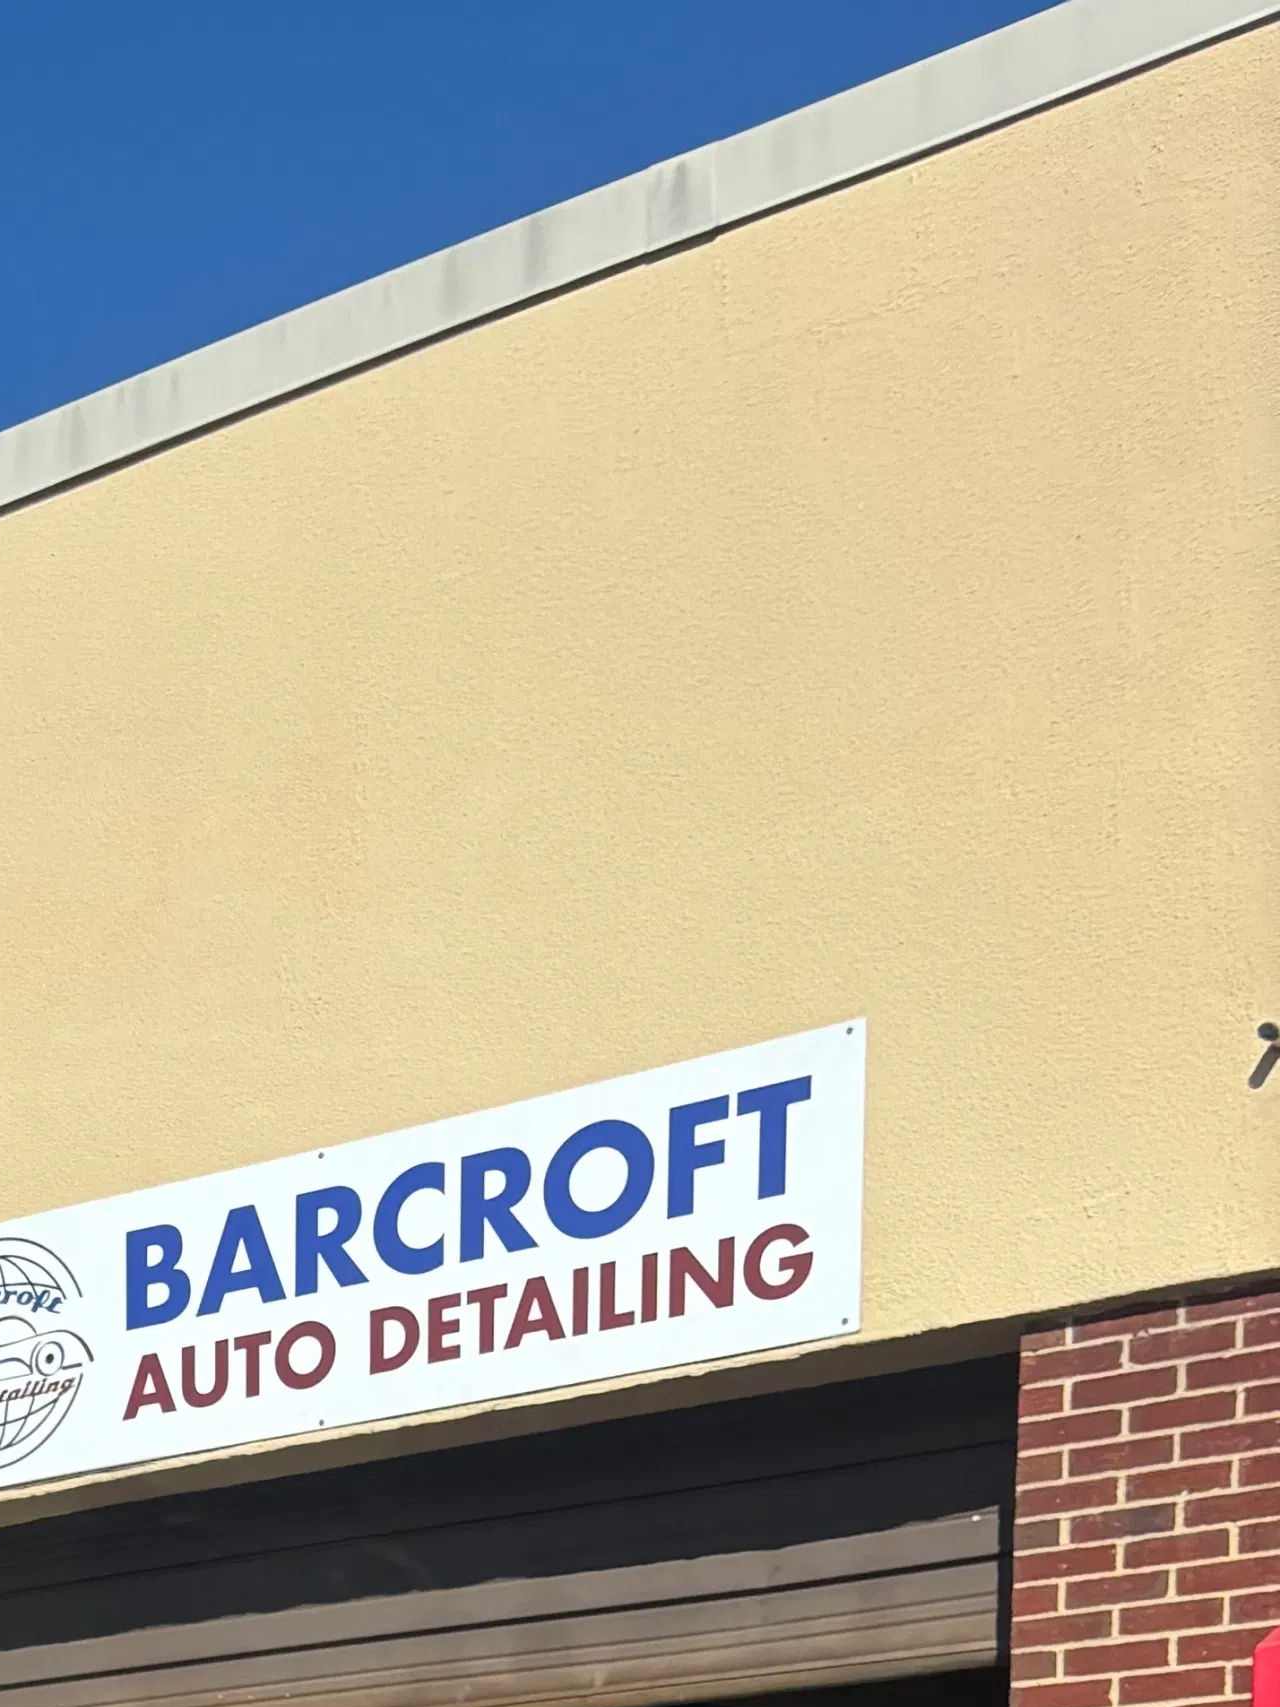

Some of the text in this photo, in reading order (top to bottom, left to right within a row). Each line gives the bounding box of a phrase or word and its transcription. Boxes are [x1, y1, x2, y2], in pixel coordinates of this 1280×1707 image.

[124, 1074, 813, 1331] BARCROFT
[121, 1221, 815, 1421] AUTO DETAILING
